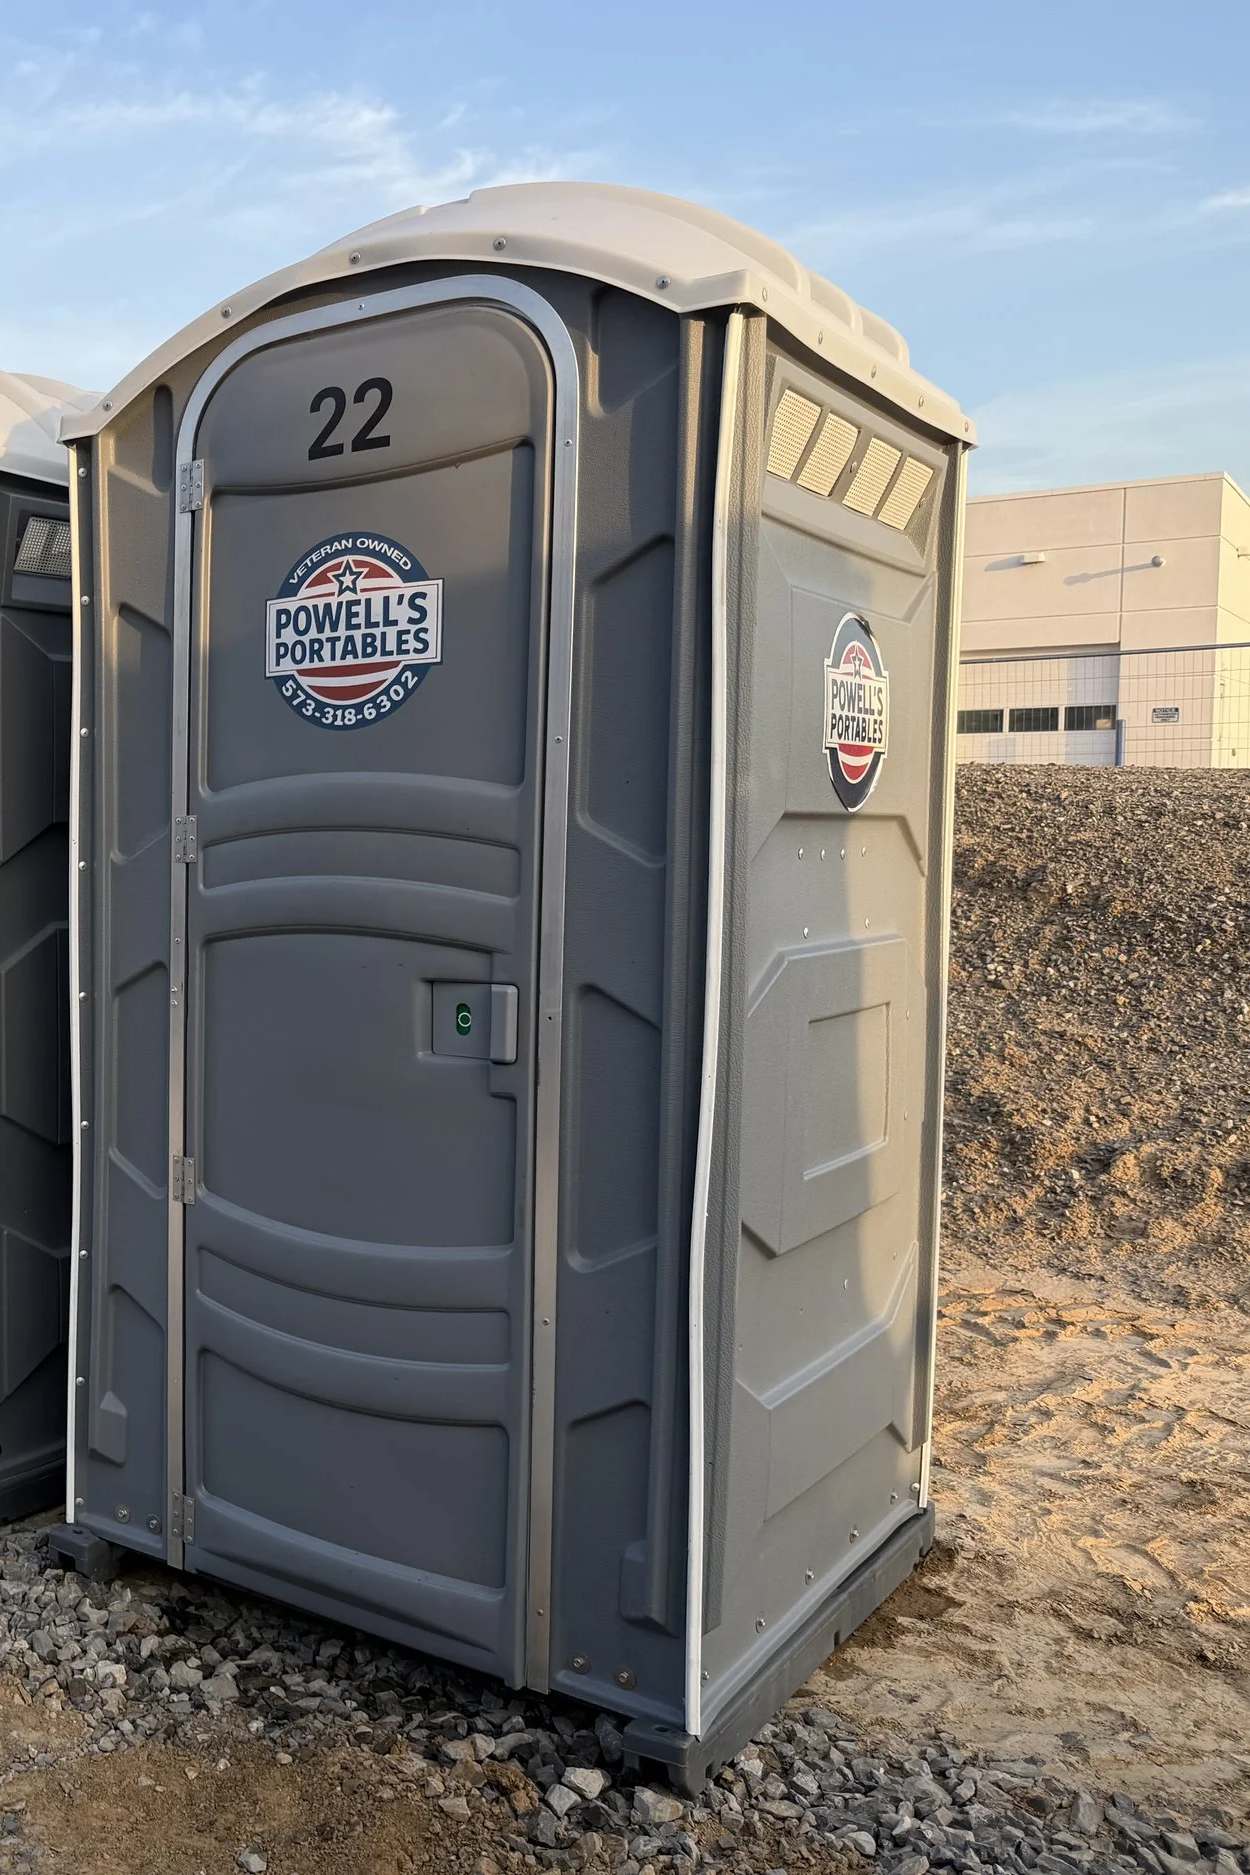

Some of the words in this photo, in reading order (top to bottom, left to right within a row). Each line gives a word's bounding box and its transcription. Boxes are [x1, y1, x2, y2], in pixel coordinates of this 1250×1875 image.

[308, 377, 393, 461] 22
[289, 538, 353, 585] VETERAN
[356, 538, 412, 571] OWNED
[275, 591, 429, 639] POWELL'S
[275, 627, 430, 667] PORTABLES
[281, 670, 419, 726] 573-318-6302
[831, 679, 883, 717] POWELL'S
[830, 715, 883, 744] PORTABLES
